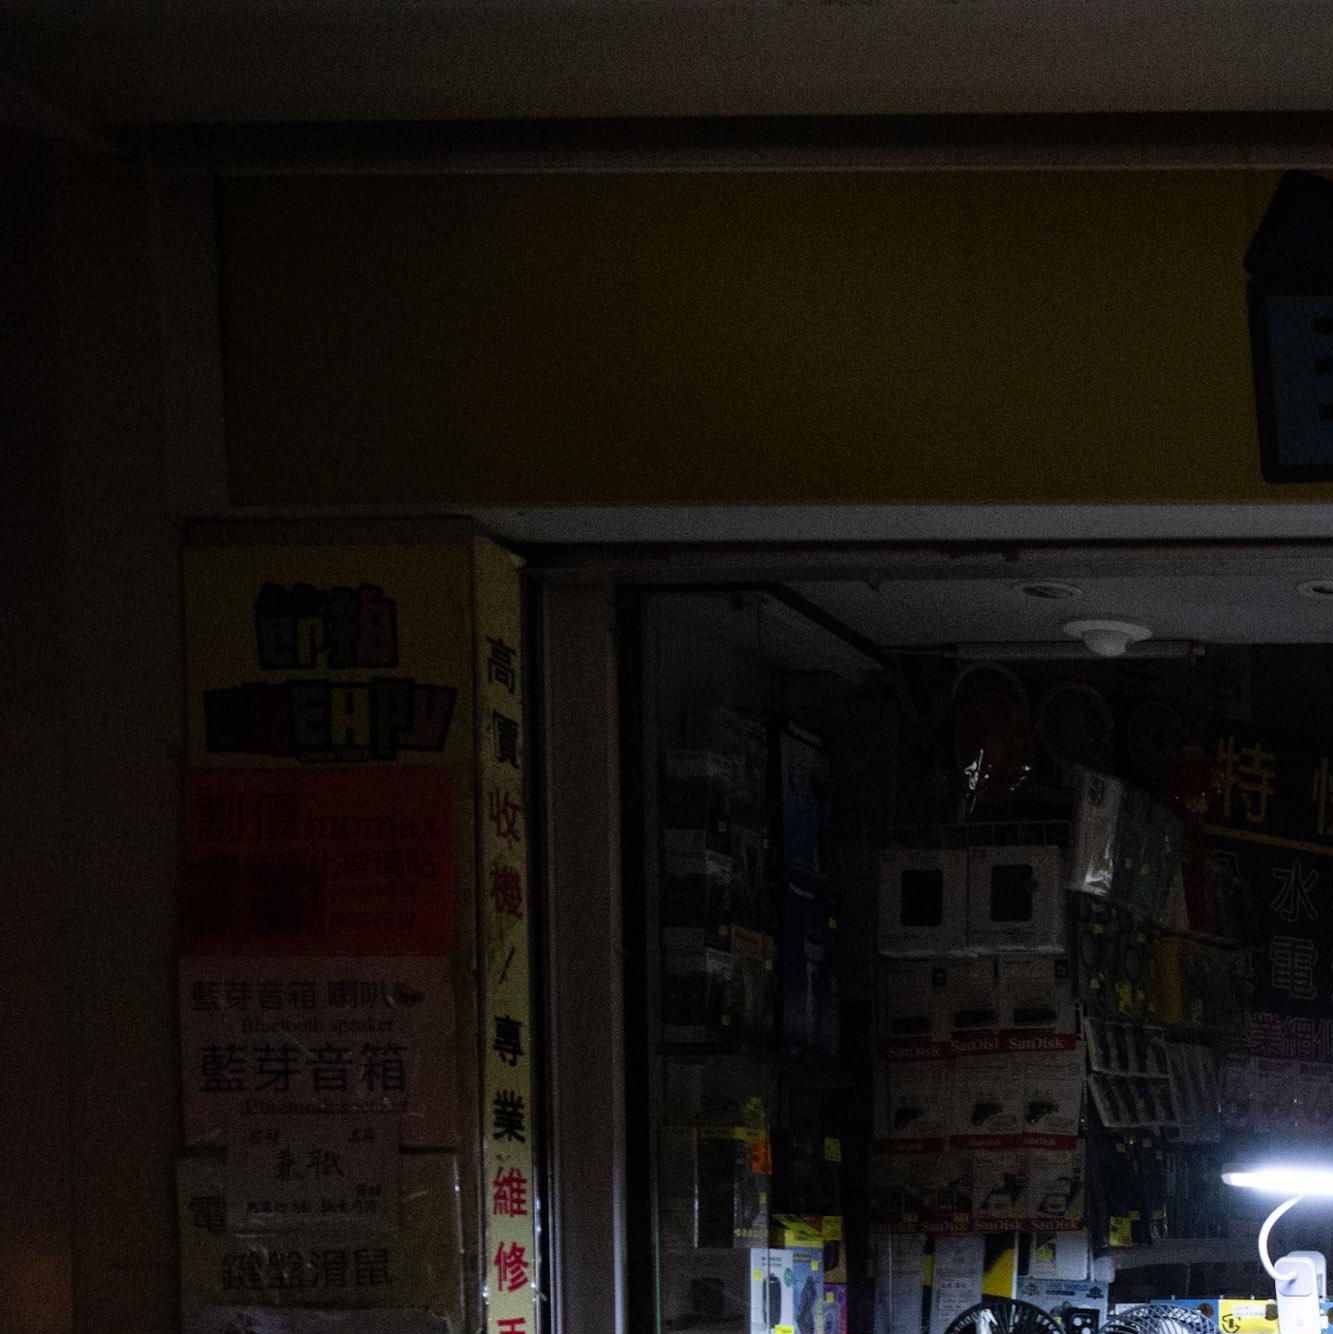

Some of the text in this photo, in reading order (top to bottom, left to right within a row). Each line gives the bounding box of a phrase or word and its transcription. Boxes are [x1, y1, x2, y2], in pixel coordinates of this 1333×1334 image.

[191, 980, 317, 1011] 藍芽音箱
[1008, 1037, 1066, 1051] SanDisk
[198, 1043, 407, 1093] 藍芽音箱
[220, 1247, 395, 1292] 鍵盤滑鼠
